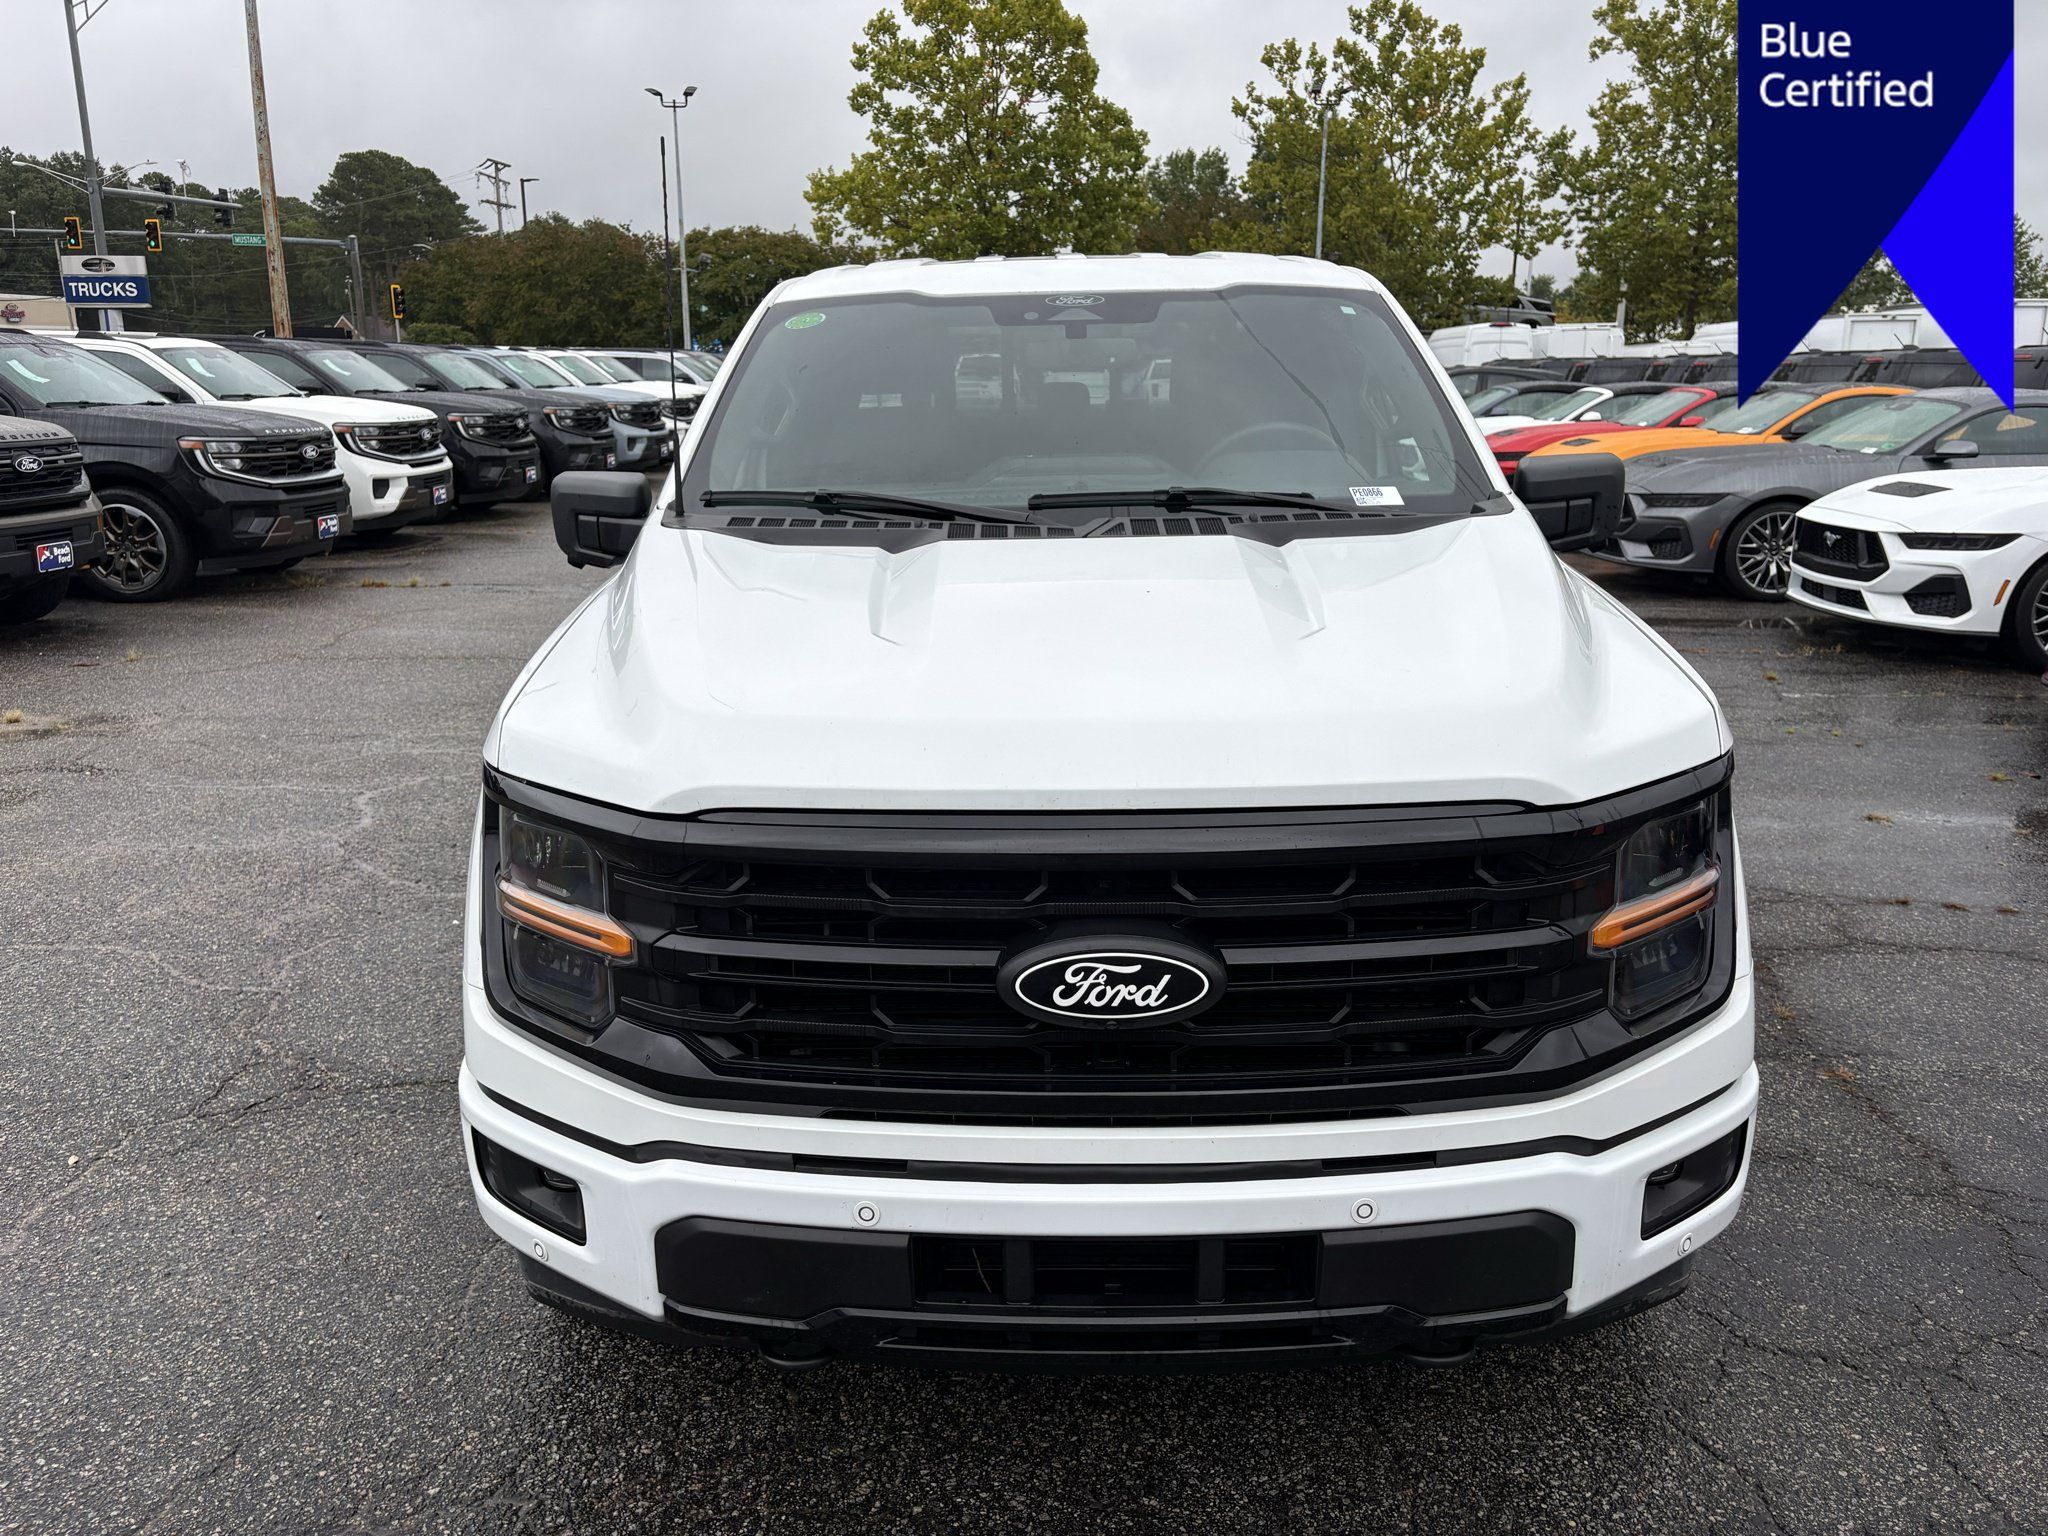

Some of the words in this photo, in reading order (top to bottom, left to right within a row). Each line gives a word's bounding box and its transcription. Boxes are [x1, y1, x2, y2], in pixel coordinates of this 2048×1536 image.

[234, 235, 262, 244] MUSTANG
[68, 281, 138, 297] TRUCKS
[1055, 295, 1095, 305] Ford
[1351, 487, 1384, 497] PE0866
[53, 545, 70, 556] Beach
[58, 554, 71, 563] Ford
[1052, 962, 1172, 1007] Ford
